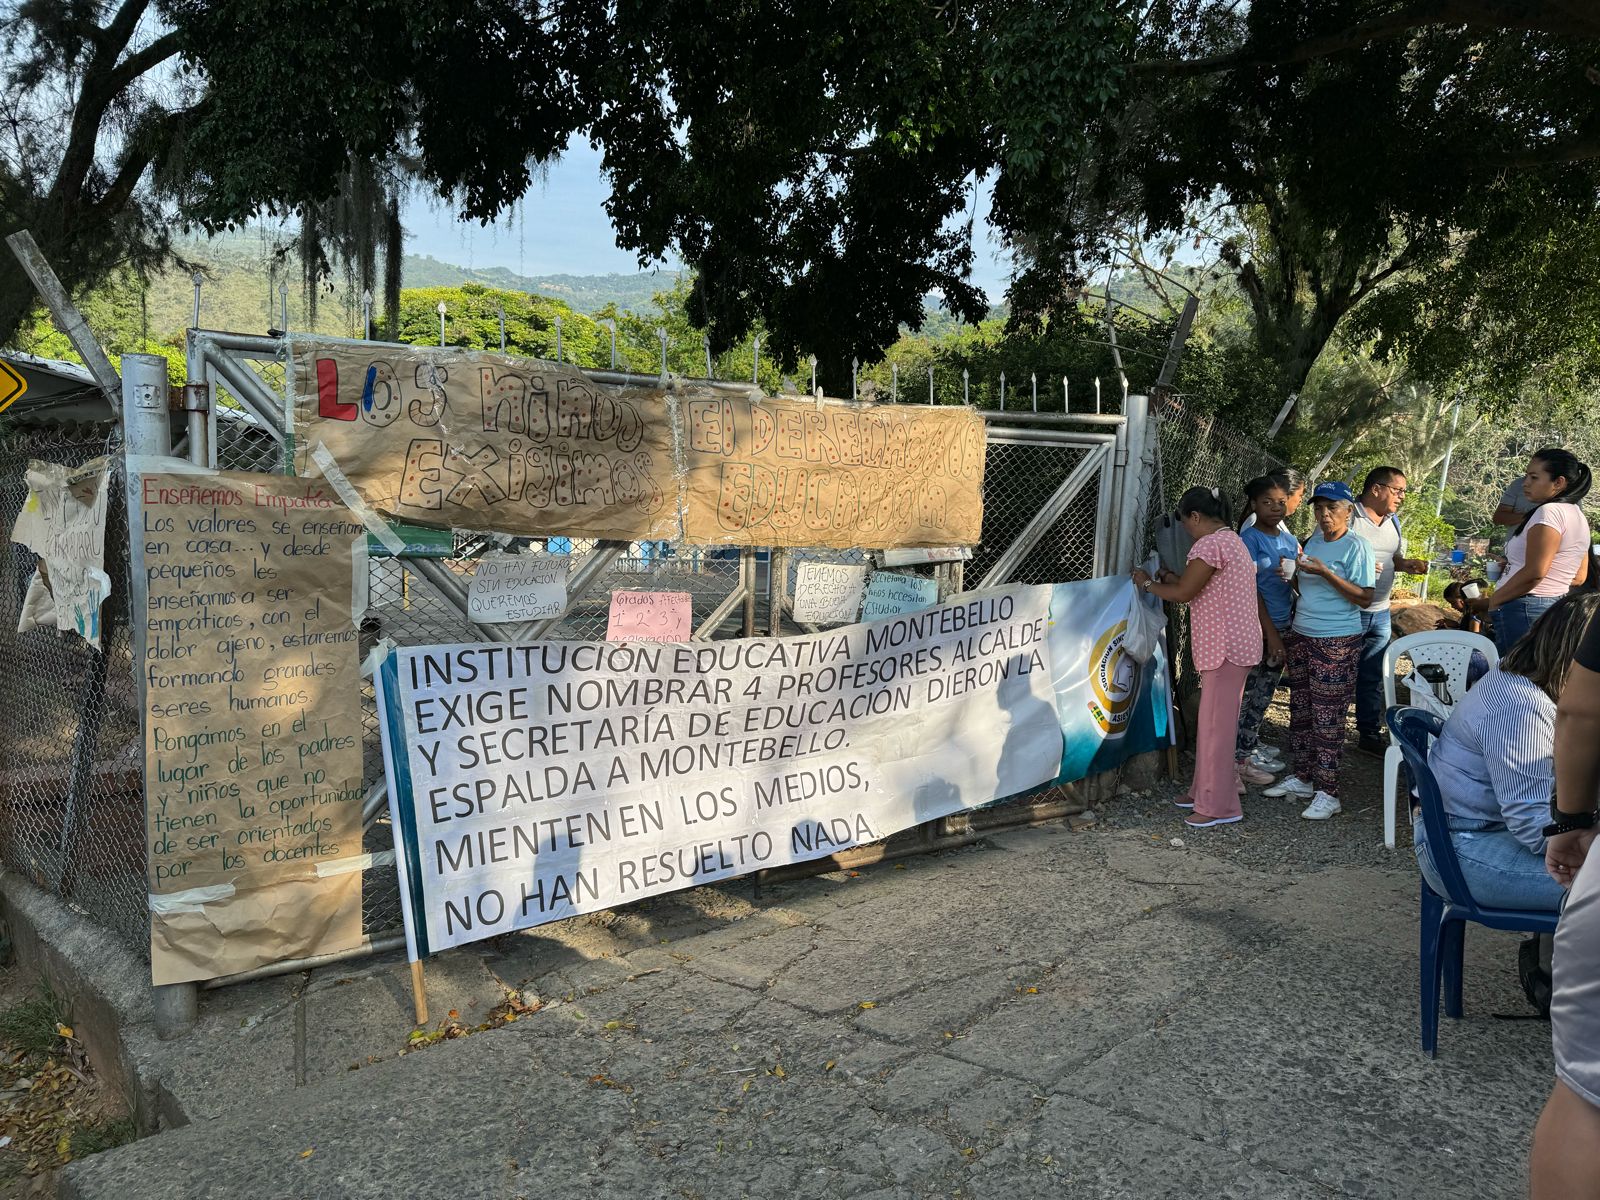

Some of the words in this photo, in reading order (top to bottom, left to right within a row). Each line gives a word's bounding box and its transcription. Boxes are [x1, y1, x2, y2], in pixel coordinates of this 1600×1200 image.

[143, 478, 243, 506] Enseñemos
[254, 484, 333, 517] Empatía
[143, 511, 175, 533] Los
[188, 508, 257, 534] valores
[272, 519, 291, 535] se
[145, 541, 170, 555] en
[260, 541, 271, 561] y
[282, 535, 331, 556] desde
[476, 562, 498, 577] NO
[503, 560, 527, 575] HAY
[147, 560, 236, 589] pequeños
[253, 557, 278, 580] les
[476, 579, 501, 594] SIN
[147, 590, 237, 611] enseñamos
[241, 591, 255, 605] a
[266, 587, 295, 602] ser
[147, 610, 255, 640] empáticos,
[261, 610, 292, 625] con
[304, 598, 321, 621] el
[470, 592, 538, 614] QUEREMOS
[505, 601, 561, 620] ESTUDIAR
[146, 636, 197, 660] dolor
[216, 635, 276, 664] ajeno,
[282, 623, 359, 649] estaremos
[409, 642, 662, 690] INSTITUCIÓN
[672, 635, 851, 674] EDUCATIVA
[865, 595, 1014, 656] MONTEBELLO
[147, 657, 245, 689] formando
[262, 652, 337, 691] grandes
[414, 687, 529, 735] EXIGE
[547, 678, 734, 716] NOMBRAR
[742, 675, 763, 701] 4
[776, 645, 947, 700] PROFESORES.
[951, 617, 1044, 667] ALCALDE
[150, 698, 212, 719] seres
[228, 684, 314, 712] humanos.
[417, 740, 441, 777] Y
[457, 706, 676, 771] SECRETARÍA
[688, 709, 733, 739] DE
[743, 684, 912, 734] EDUCACIÓN
[927, 657, 1011, 704] DIERON
[1016, 648, 1046, 676] LA
[261, 723, 282, 739] en
[291, 707, 306, 734] el
[157, 758, 210, 794] lugar
[227, 752, 249, 774] de
[261, 742, 285, 767] los
[298, 722, 356, 769] padres
[429, 760, 597, 825] ESPALDA
[606, 755, 631, 789] A
[640, 728, 851, 783] MONTEBELLO.
[153, 810, 218, 833] tienen
[238, 798, 256, 819] la
[268, 783, 370, 821] oportunidad
[156, 794, 169, 817] y
[186, 781, 241, 806] niños
[256, 775, 290, 801] que
[303, 767, 326, 786] no
[153, 831, 178, 856] de
[186, 833, 220, 850] ser
[236, 811, 333, 846] orientados
[435, 809, 612, 876] MIENTEN
[618, 800, 664, 838] EN
[679, 786, 738, 826] LOS
[753, 761, 870, 811] MEDIOS,
[155, 858, 193, 888] por
[221, 850, 246, 872] los
[262, 832, 341, 864] docentes
[444, 889, 505, 937] NO
[519, 867, 600, 917] HAN
[617, 830, 773, 895] RESUELTO
[790, 812, 881, 855] NADA.
